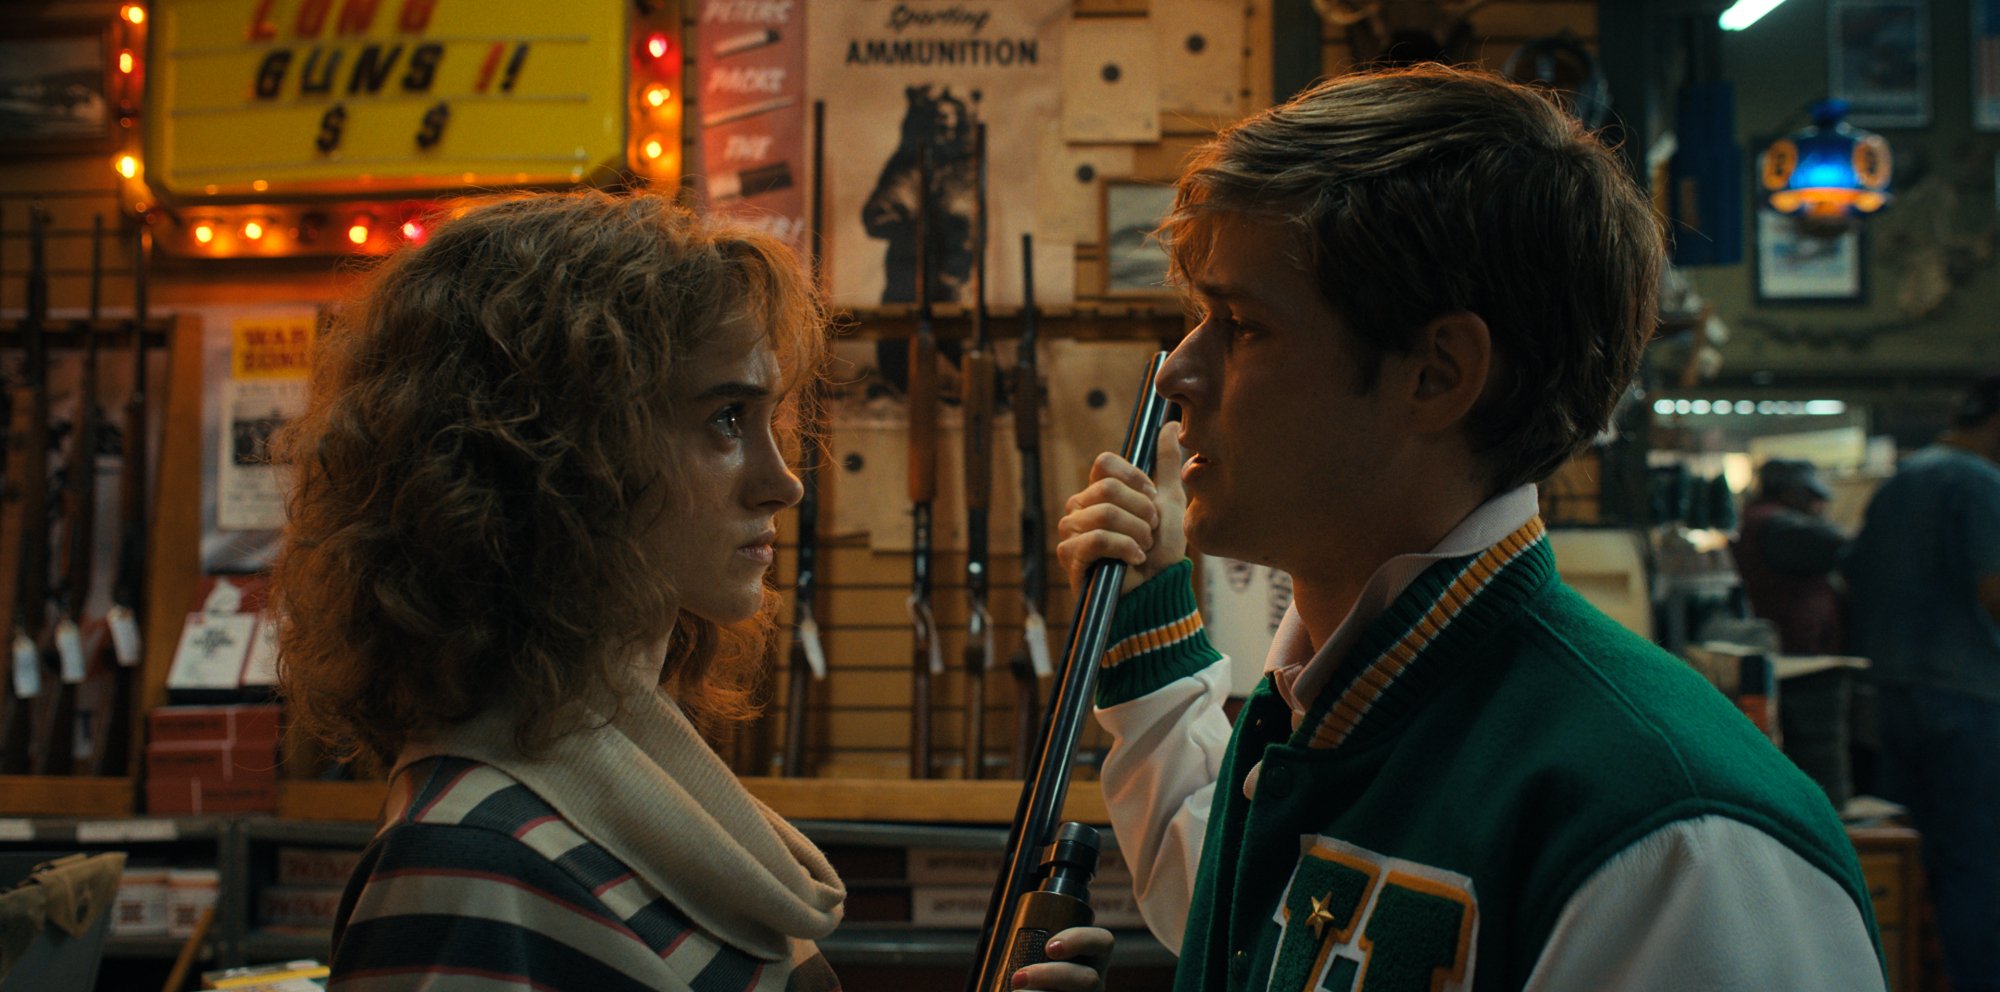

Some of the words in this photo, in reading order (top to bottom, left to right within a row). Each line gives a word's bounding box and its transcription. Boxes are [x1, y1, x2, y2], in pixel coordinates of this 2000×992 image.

[846, 38, 1038, 65] AMMUNITION
[256, 44, 445, 98] GUNS
[707, 67, 787, 93] PACKS
[316, 103, 346, 153] $
[417, 102, 449, 149] $
[246, 328, 308, 346] WAR
